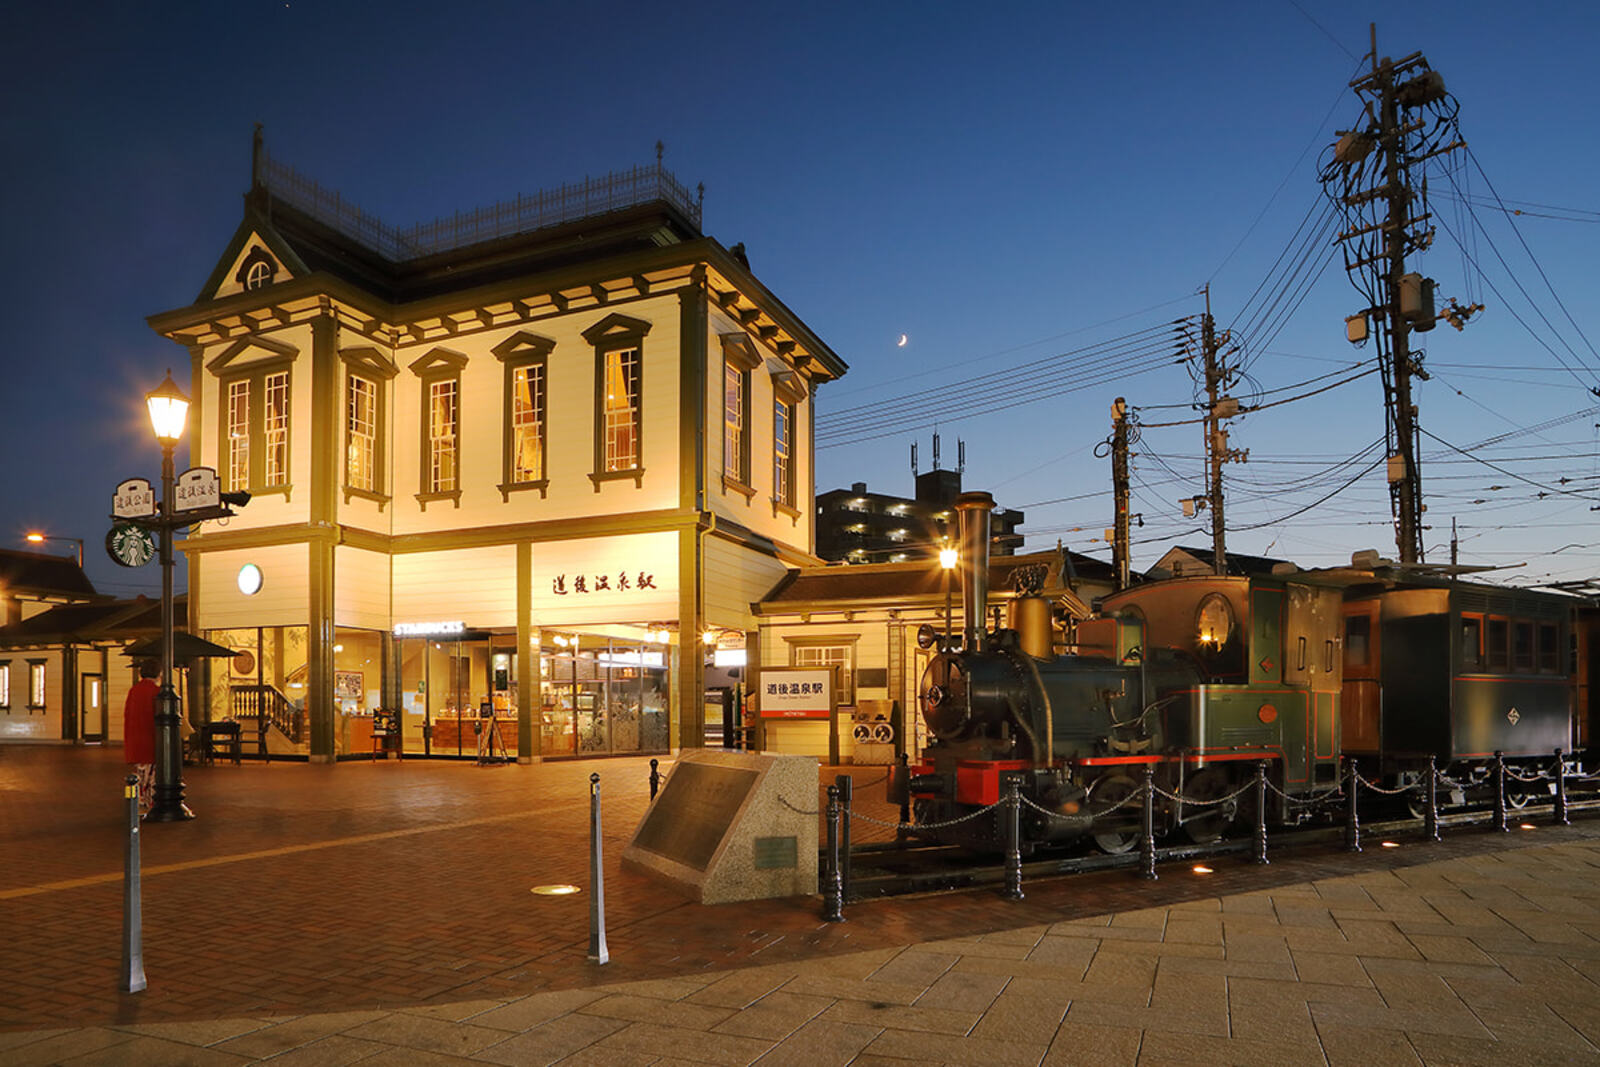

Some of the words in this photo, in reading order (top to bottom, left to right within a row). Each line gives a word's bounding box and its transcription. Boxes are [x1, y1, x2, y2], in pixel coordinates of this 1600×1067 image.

[552, 570, 657, 595] 道後温泉駅
[767, 682, 823, 695] 道後温泉駅
